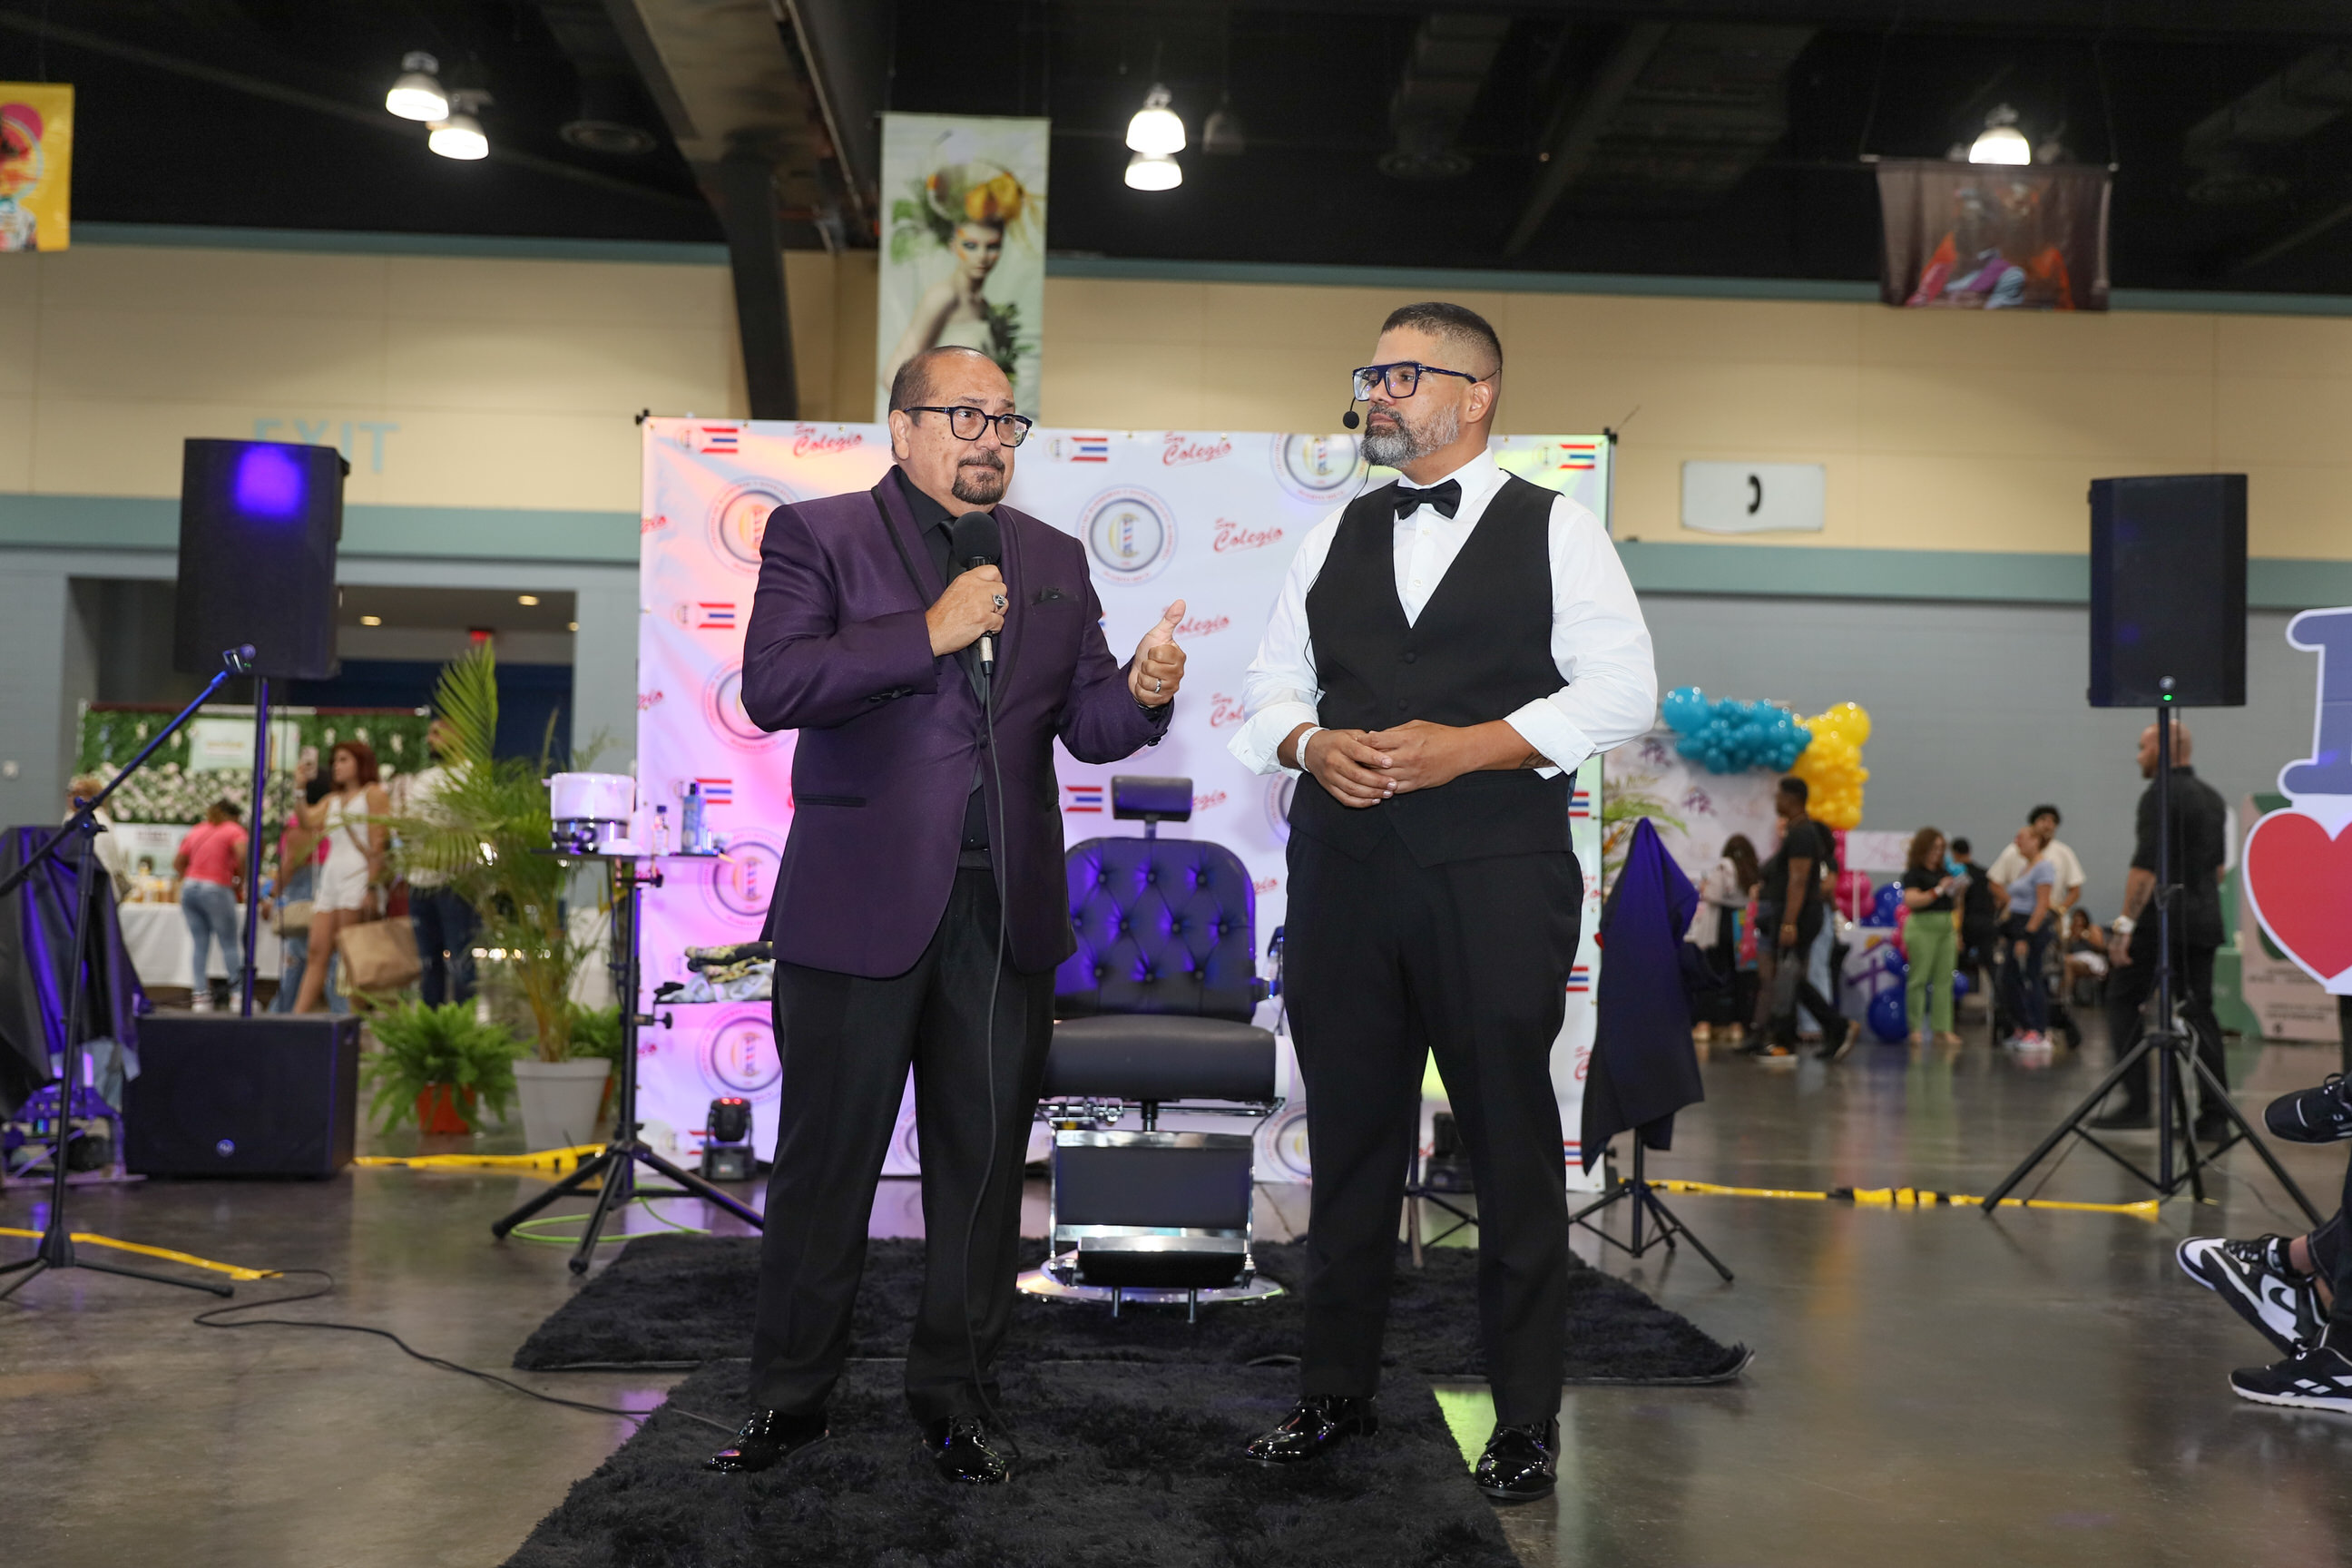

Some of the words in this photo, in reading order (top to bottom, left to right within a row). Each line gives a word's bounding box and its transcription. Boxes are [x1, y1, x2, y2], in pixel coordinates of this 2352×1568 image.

[793, 433, 863, 458] Colegio
[1162, 441, 1231, 466] Colegio
[1213, 526, 1283, 553] Colegio
[1176, 615, 1230, 636] olegio
